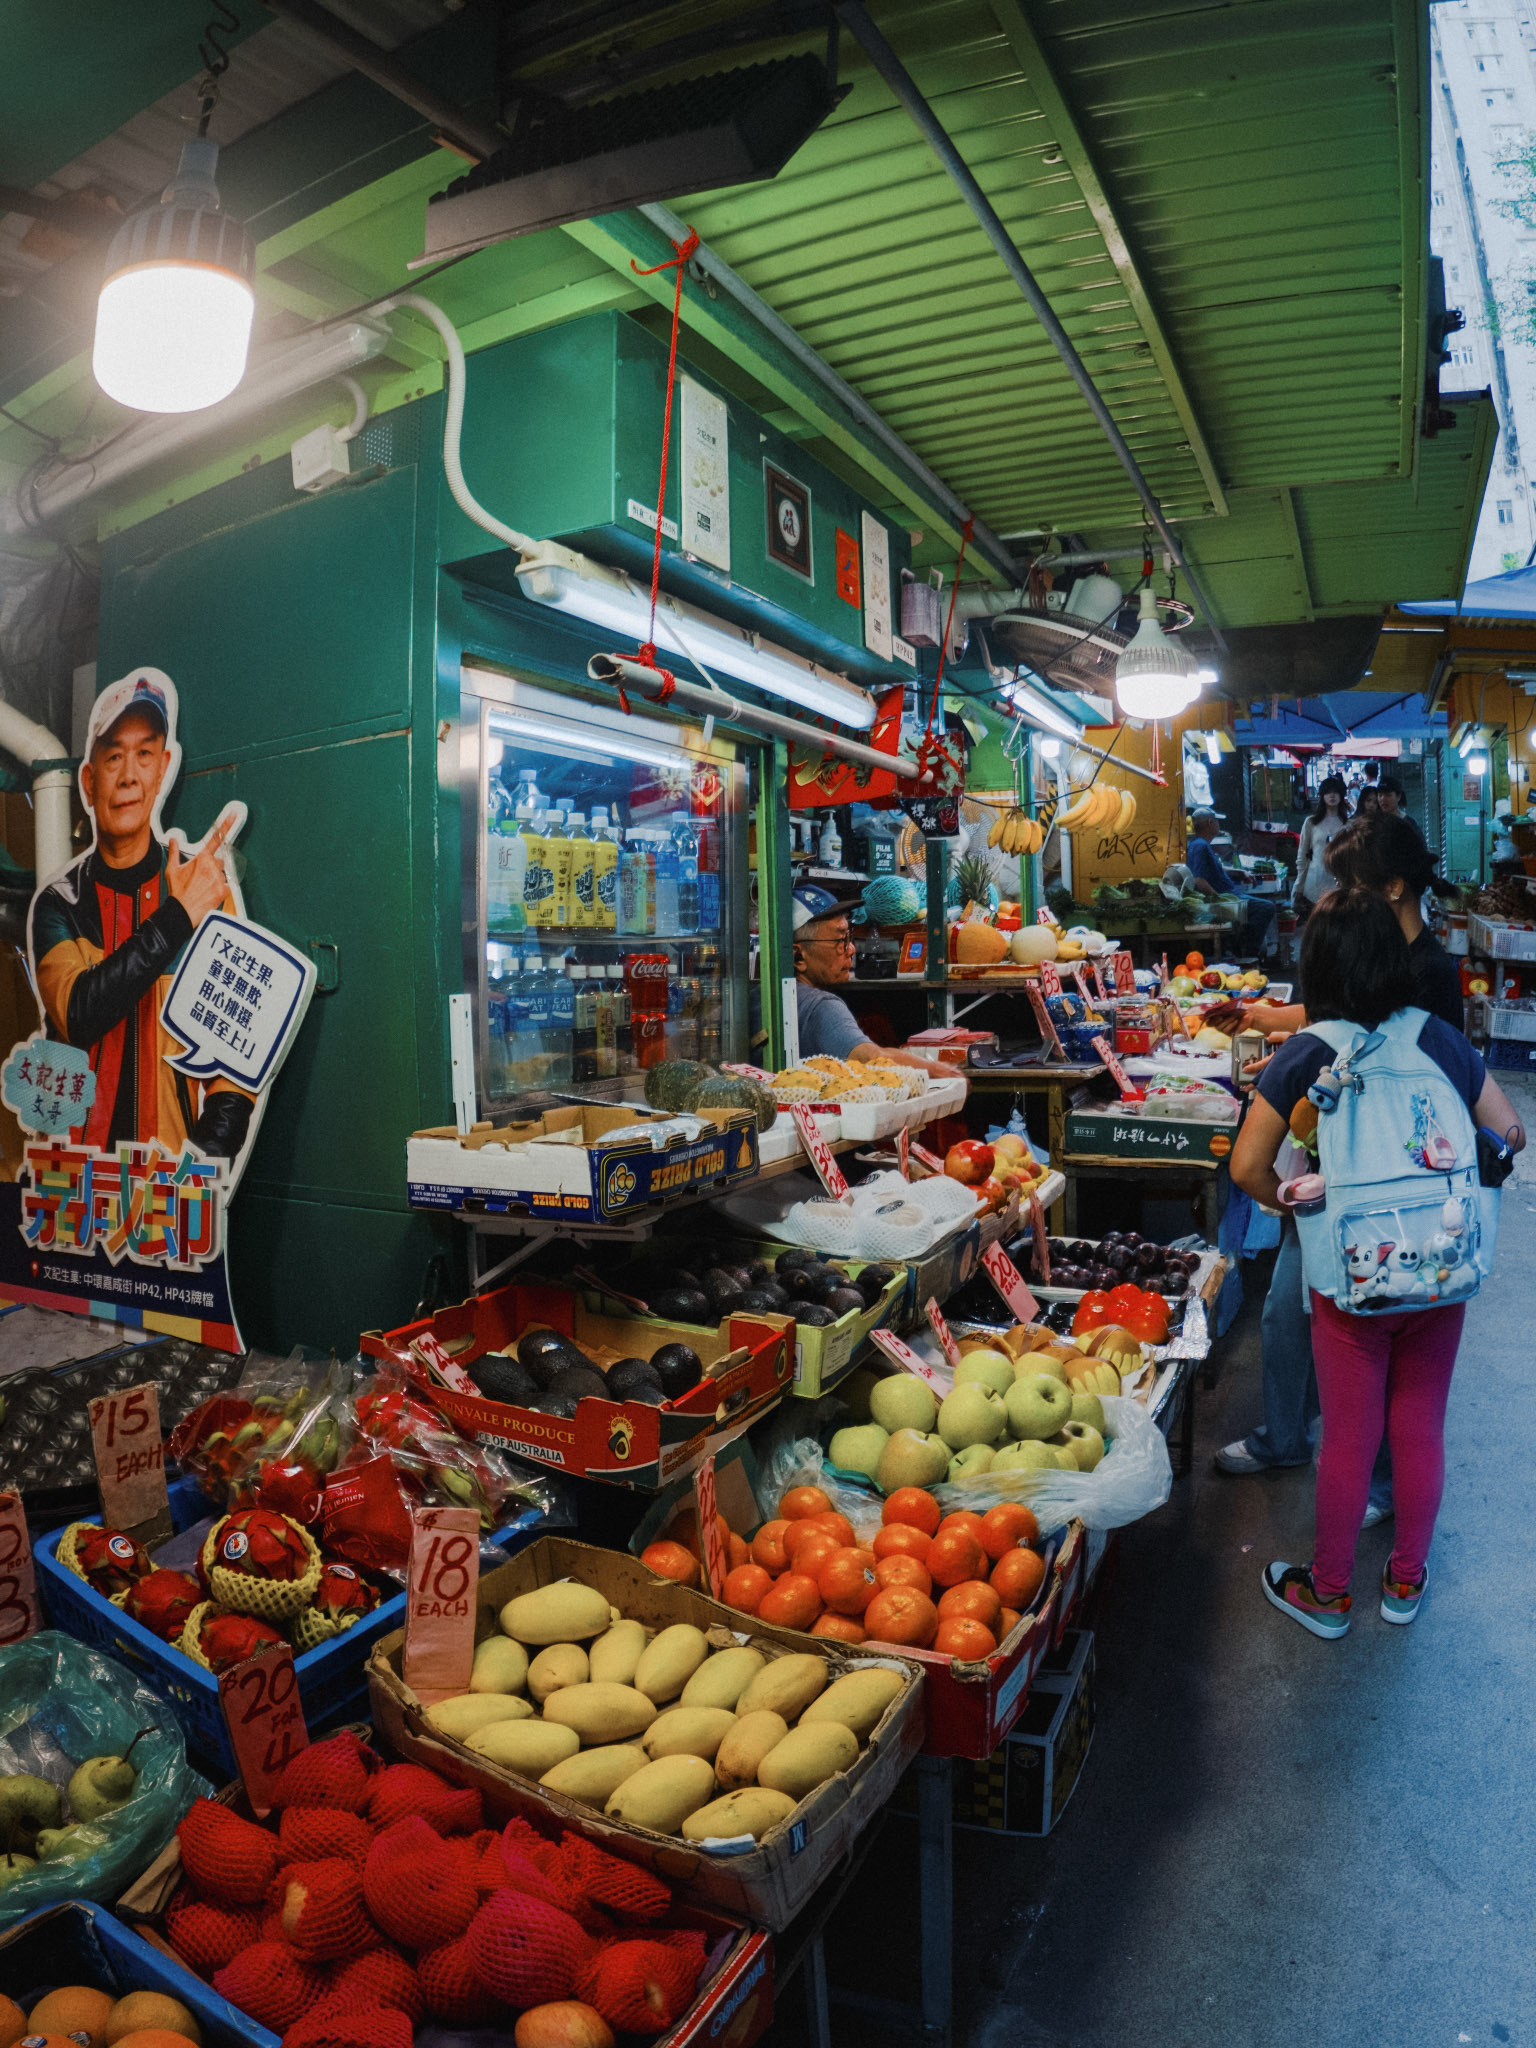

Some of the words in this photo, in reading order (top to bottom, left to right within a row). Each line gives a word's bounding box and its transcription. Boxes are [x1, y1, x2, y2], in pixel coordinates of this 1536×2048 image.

[695, 1149, 725, 1179] GOLD
[813, 1142, 831, 1177] 30
[650, 1160, 692, 1192] PRIZE
[25, 1142, 217, 1265] 嘉咸節
[532, 1193, 562, 1207] PRIZE
[563, 1196, 590, 1210] GOLD
[91, 1390, 150, 1448] $15
[503, 1416, 576, 1446] PRODUCE
[115, 1442, 163, 1484] EACH
[492, 1433, 506, 1446] OF
[507, 1437, 563, 1464] AUSTRALIA
[417, 1600, 469, 1618] EACH
[223, 1658, 297, 1725] $20
[271, 1703, 299, 1734] FOR
[261, 1731, 308, 1774] 4
